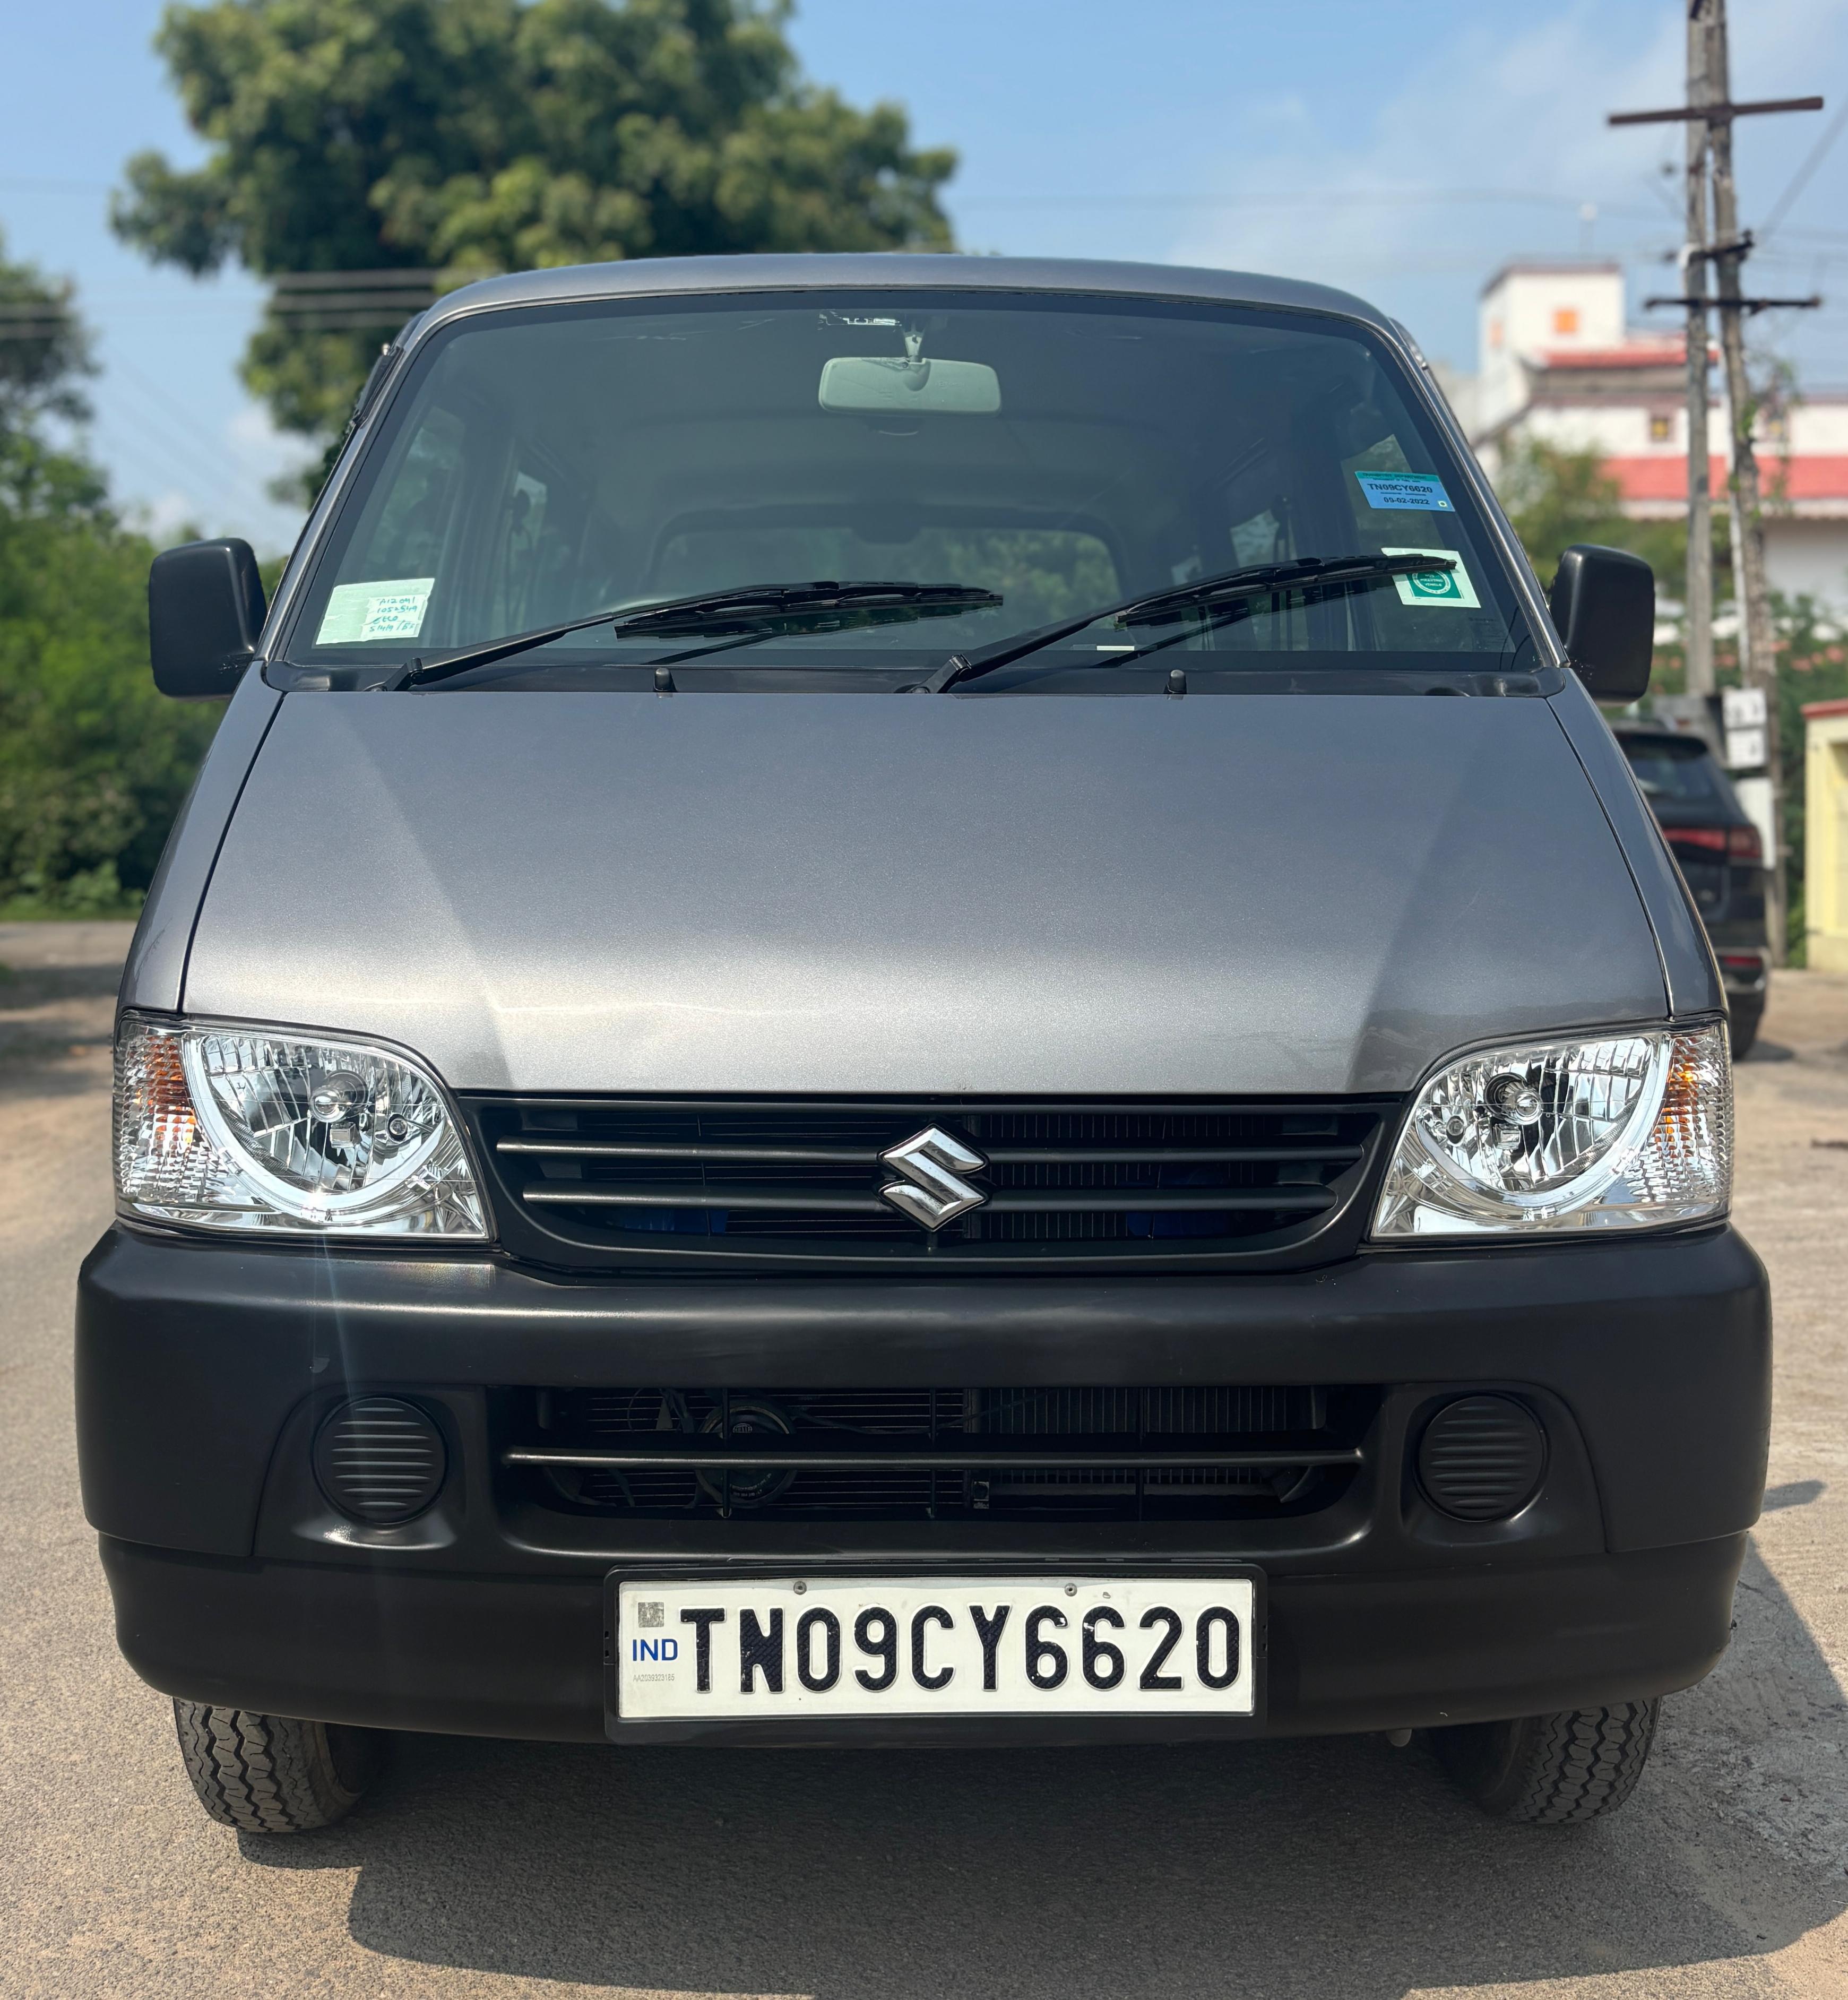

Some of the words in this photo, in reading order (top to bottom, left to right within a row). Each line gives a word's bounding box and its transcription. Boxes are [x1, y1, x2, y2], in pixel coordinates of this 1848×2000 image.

[1367, 484, 1433, 493] TN09CY6620
[633, 1639, 678, 1661] IND
[680, 1603, 1241, 1692] TN09CY6620
